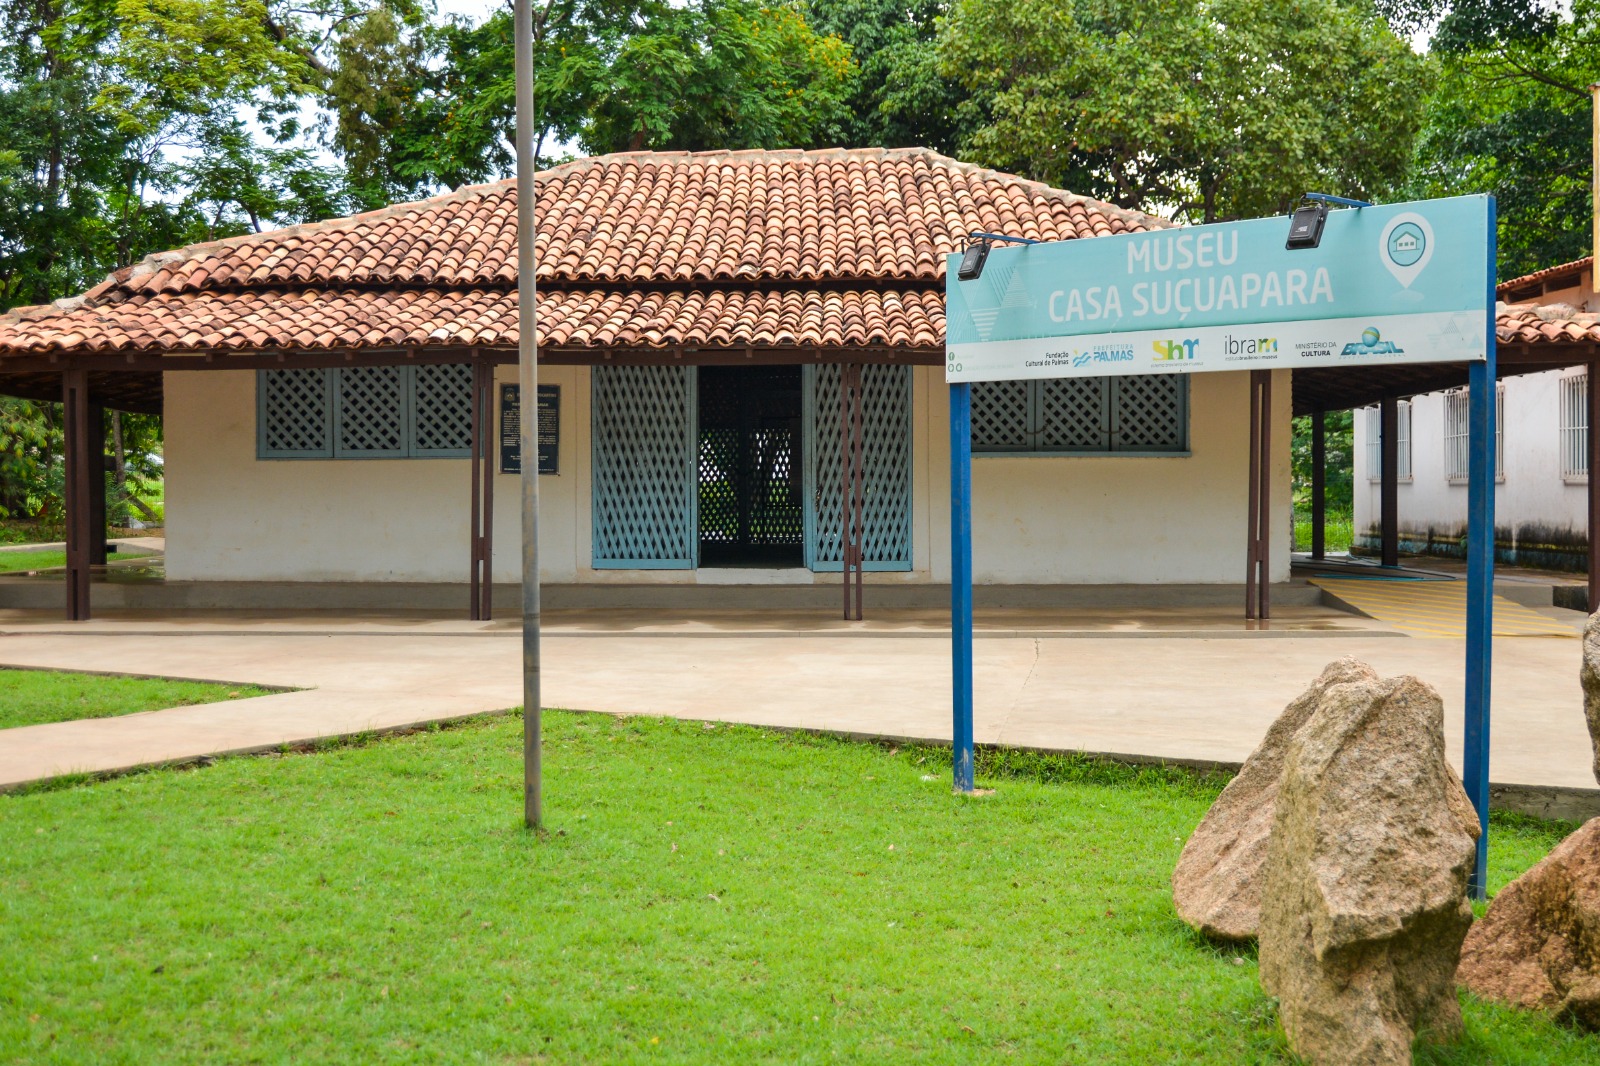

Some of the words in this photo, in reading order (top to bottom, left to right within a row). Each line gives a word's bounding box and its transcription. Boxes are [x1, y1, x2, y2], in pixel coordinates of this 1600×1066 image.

[1127, 229, 1238, 274] MUSEU
[1049, 285, 1123, 322] CASA
[1132, 267, 1334, 321] SUÇUAPARA
[1225, 335, 1278, 354] ibram
[1295, 341, 1328, 349] MINISTÉRIO
[1340, 341, 1405, 355] BRASIL
[1093, 350, 1134, 362] PALMAS
